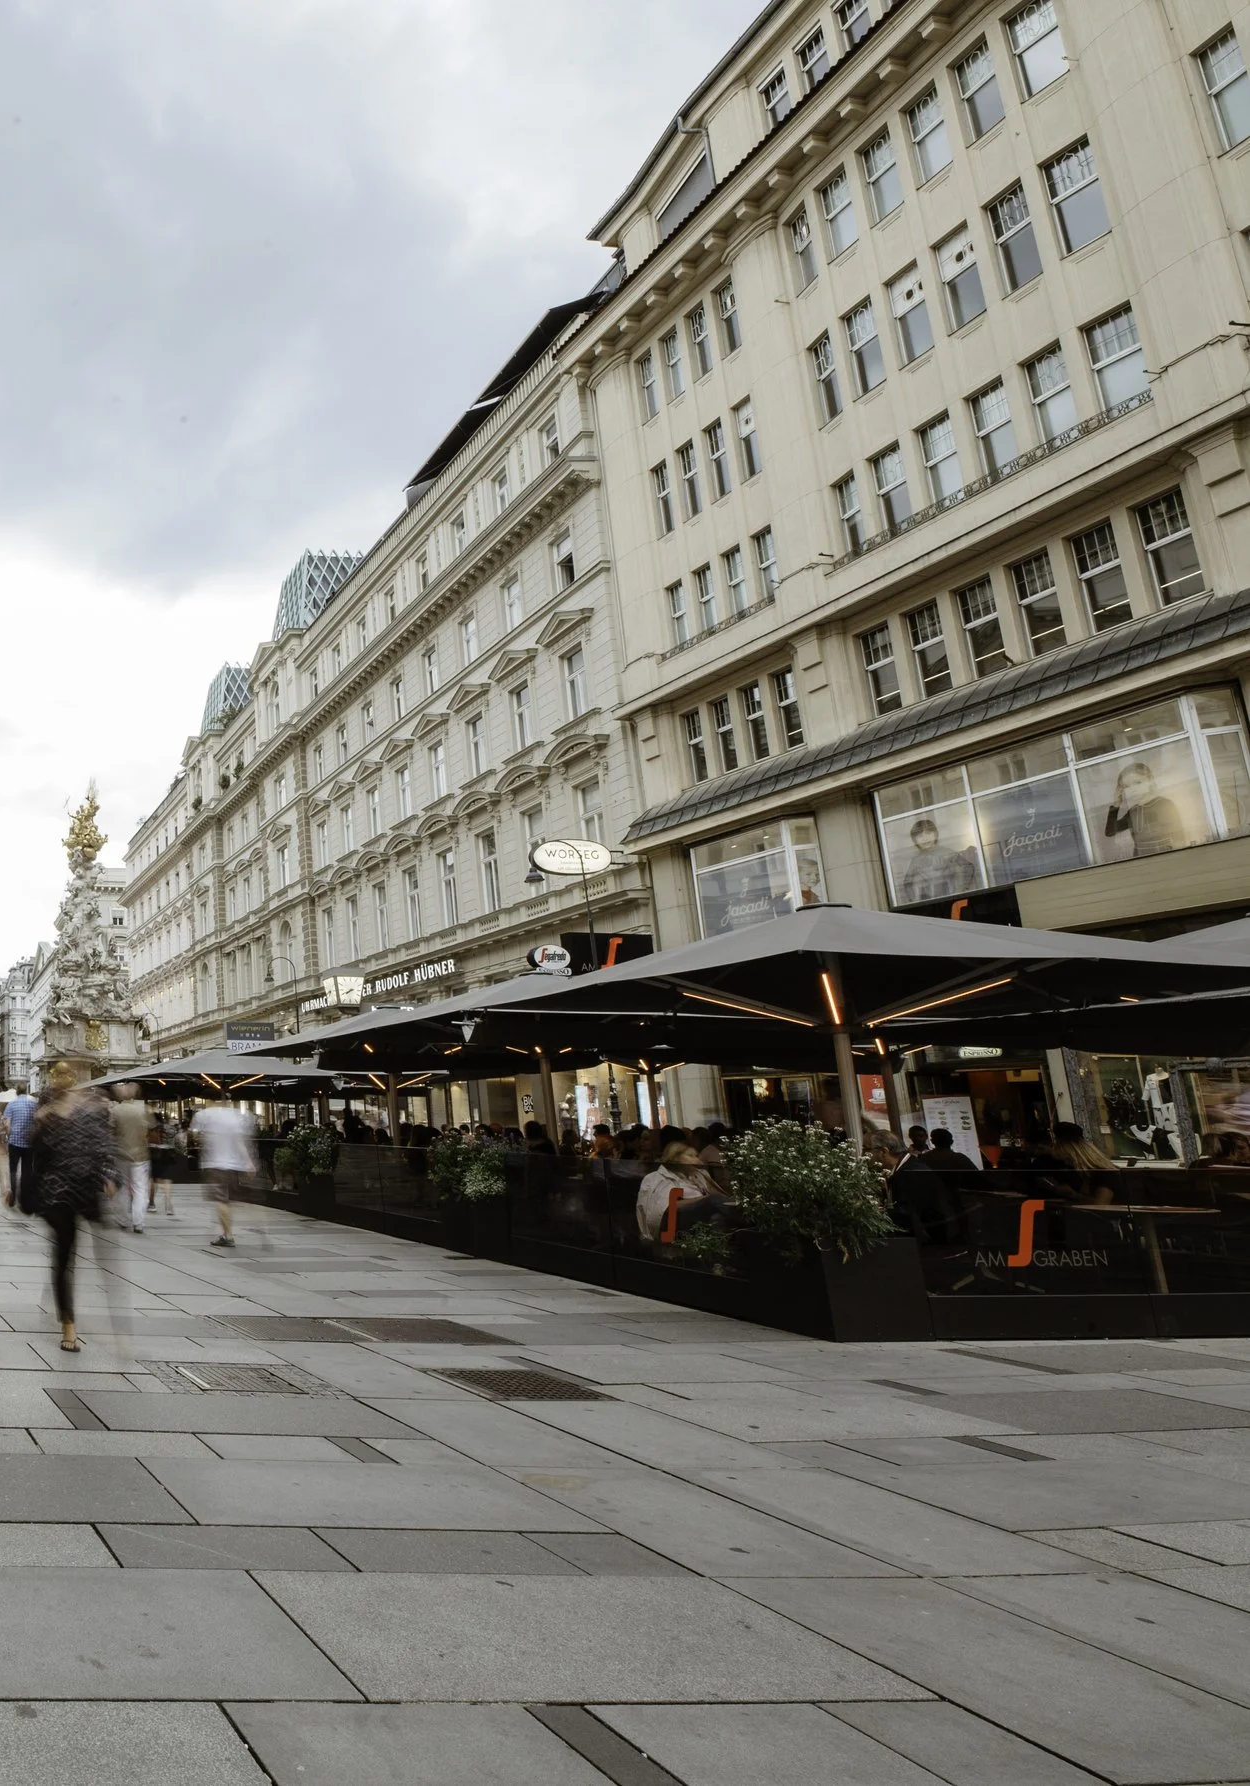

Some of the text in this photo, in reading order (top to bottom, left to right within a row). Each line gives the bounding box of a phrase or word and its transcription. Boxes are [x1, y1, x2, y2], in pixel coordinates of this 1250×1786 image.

[545, 849, 600, 860] WORSEG
[1003, 824, 1063, 857] jacadi
[721, 896, 770, 927] jacadi
[375, 971, 409, 994] RUDOLF
[414, 958, 455, 983] HÜBNER
[975, 1250, 1006, 1267] AM
[1033, 1250, 1109, 1267] GRABEN
